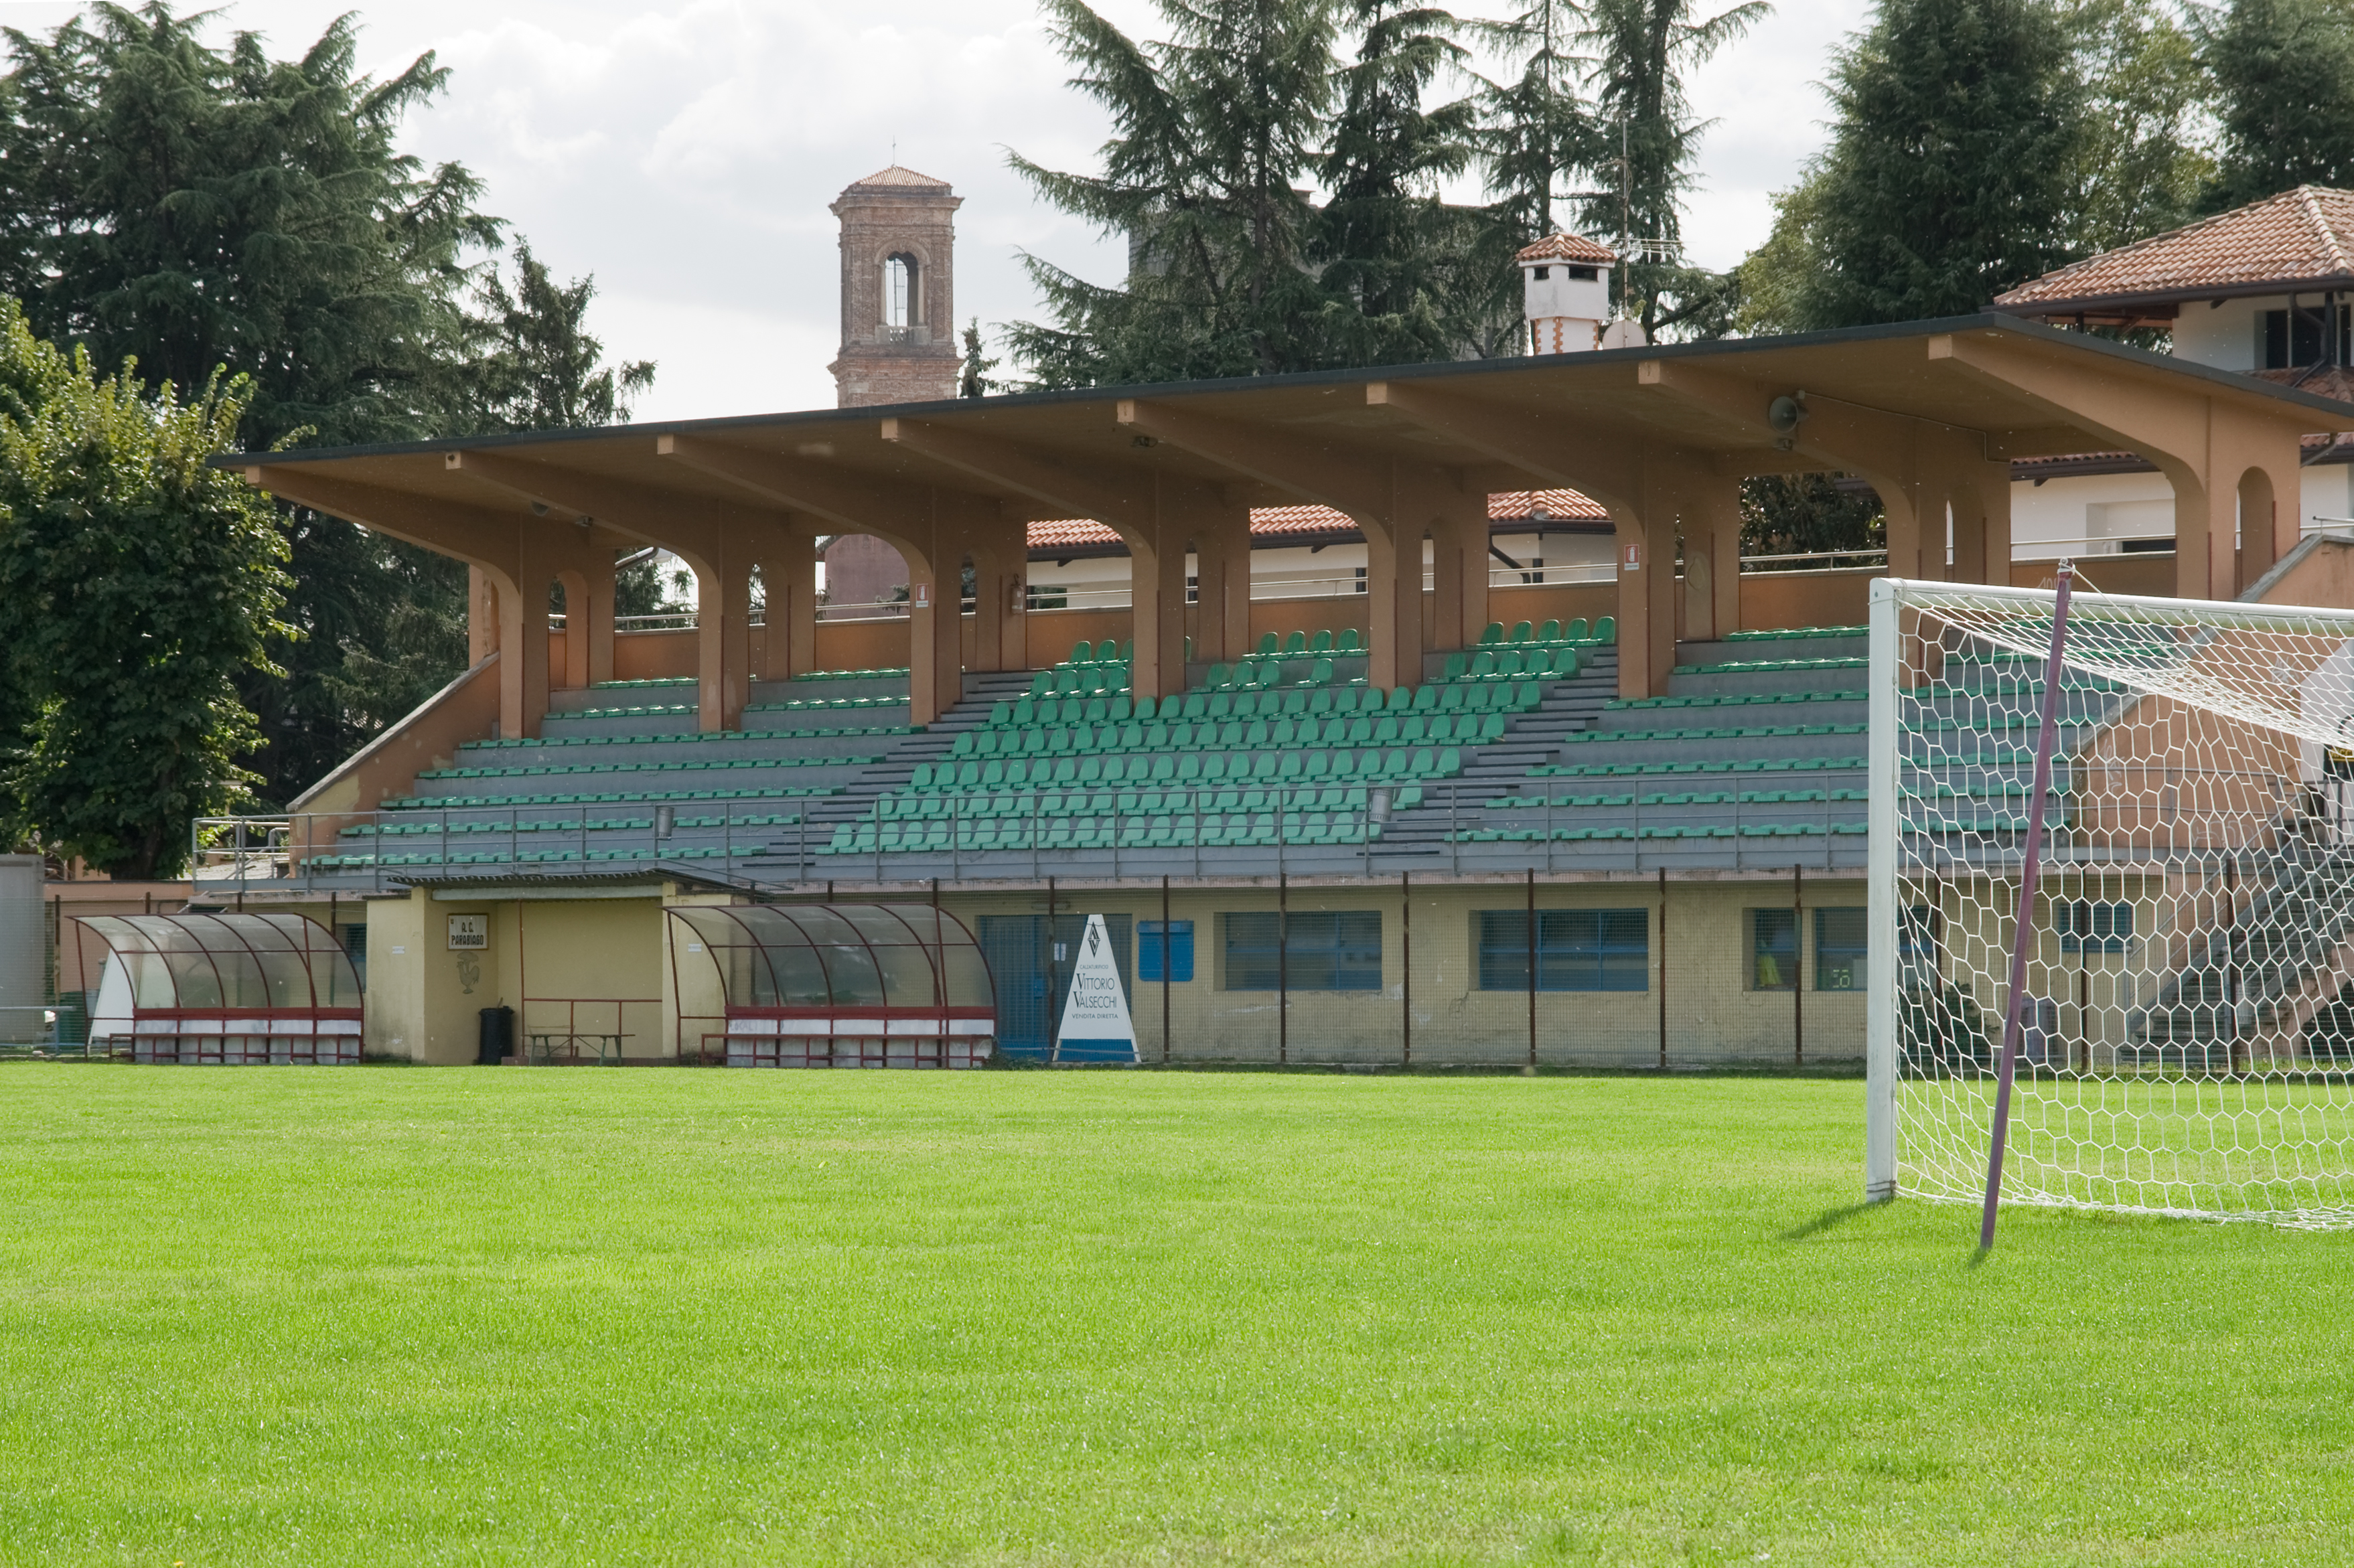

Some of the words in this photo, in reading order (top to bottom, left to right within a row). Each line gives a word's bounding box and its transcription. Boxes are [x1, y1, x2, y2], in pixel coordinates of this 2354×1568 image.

[451, 935, 484, 945] PARABIAGO
[1076, 973, 1115, 990] VITTORIO
[1073, 991, 1117, 1008] VALSECCHI
